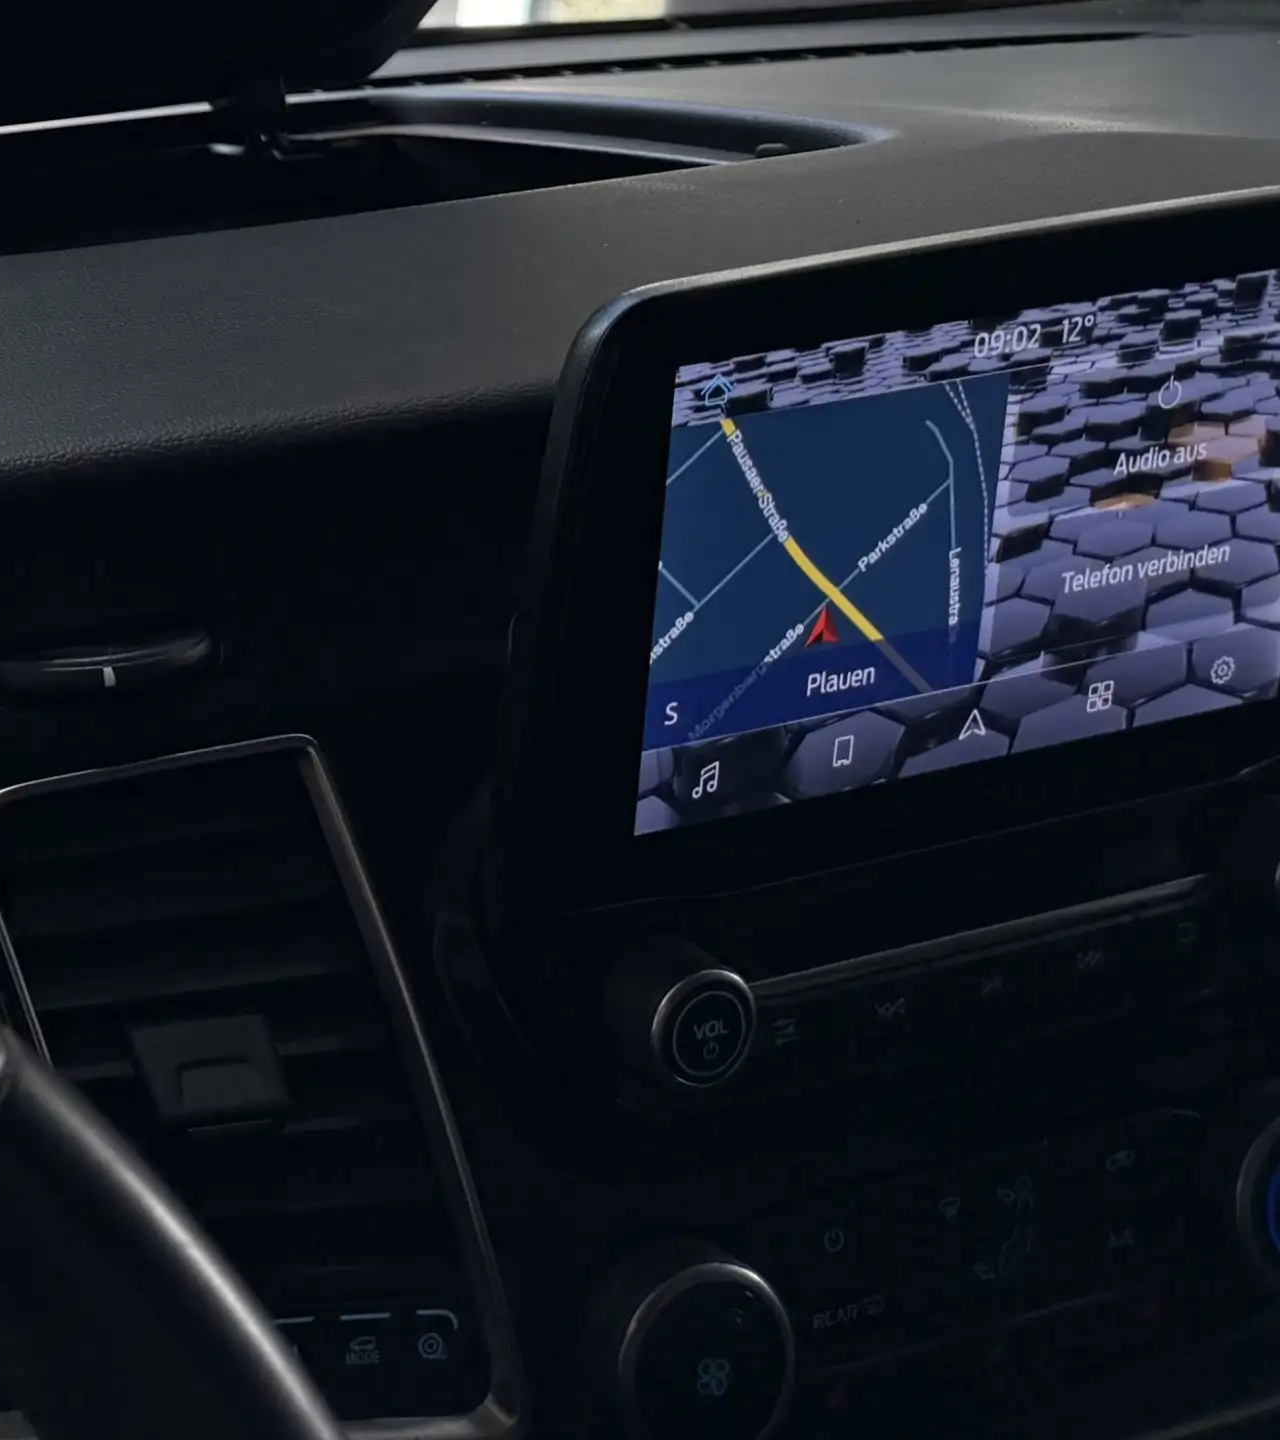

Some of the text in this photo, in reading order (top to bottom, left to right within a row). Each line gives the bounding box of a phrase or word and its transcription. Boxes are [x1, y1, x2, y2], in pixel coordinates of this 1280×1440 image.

[974, 315, 1094, 358] 09:02 12°
[1113, 442, 1208, 477] Audio aus
[726, 428, 789, 543] Pausaer Straße
[857, 502, 928, 572] Parkstraße
[1061, 545, 1230, 594] Telefon verbinden
[806, 666, 876, 697] Plauen
[664, 702, 678, 726] S
[693, 1017, 730, 1041] VOL
